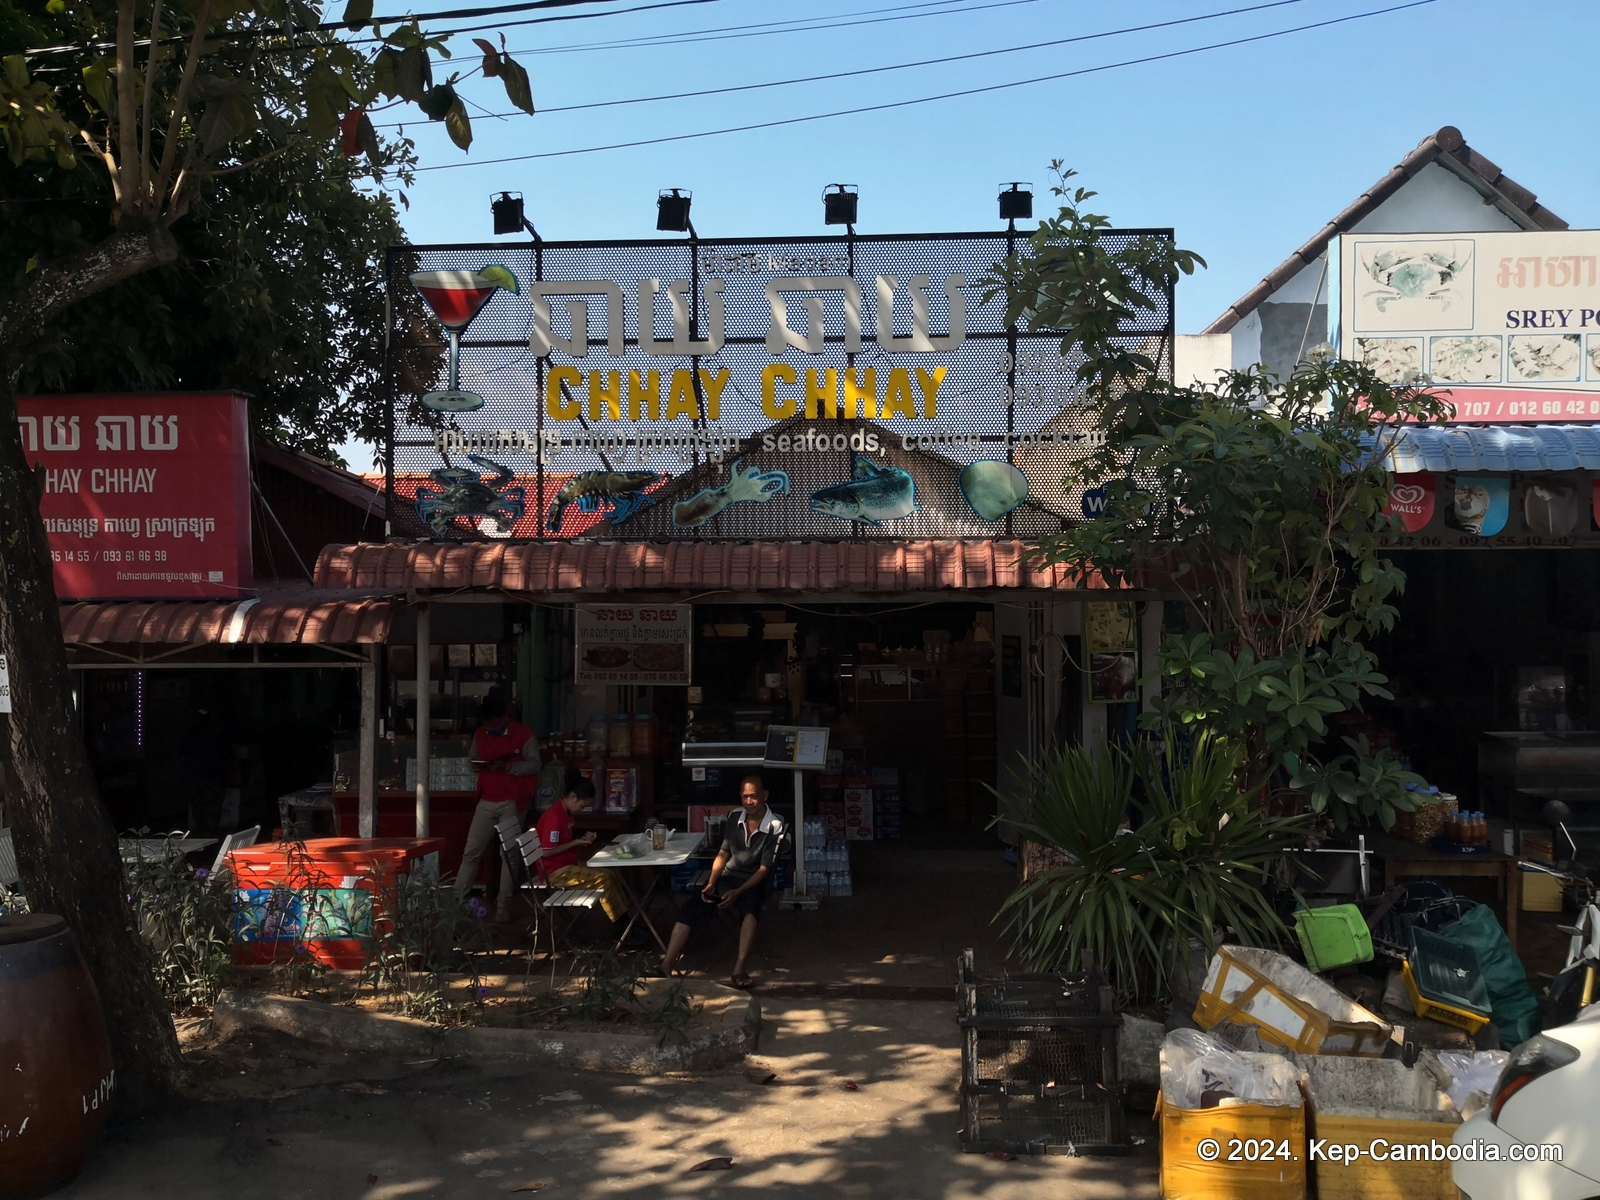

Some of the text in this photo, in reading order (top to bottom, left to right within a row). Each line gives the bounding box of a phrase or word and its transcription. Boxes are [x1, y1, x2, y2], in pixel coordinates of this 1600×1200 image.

[768, 253, 850, 271] Madam
[1497, 255, 1598, 288] អាហា
[529, 273, 965, 356] ឆាយ ឆាយ
[1506, 309, 1573, 329] SREY
[998, 351, 1047, 374] 092
[547, 364, 947, 421] CHHAY CHHAY
[998, 385, 1047, 407] 093
[1464, 402, 1490, 416] 707
[1496, 401, 1504, 416] /
[1509, 401, 1537, 416] 012
[1542, 400, 1561, 415] 60
[1566, 400, 1585, 415] 42
[17, 414, 179, 451] ាយ ឆាយ
[762, 428, 886, 457] seafoods,
[901, 428, 988, 456] coffee,
[45, 468, 157, 494] HAY CHHAY
[1391, 504, 1422, 514] WALL'S
[42, 517, 98, 538] ារសមុទ្រ
[1421, 536, 1441, 546] 06
[1459, 536, 1490, 546] 097
[1496, 536, 1516, 546] 55
[64, 550, 74, 562] 14
[77, 550, 90, 562] 55
[93, 550, 99, 562] /
[103, 550, 122, 562] 093
[138, 550, 151, 562] 86
[154, 550, 167, 562] 98
